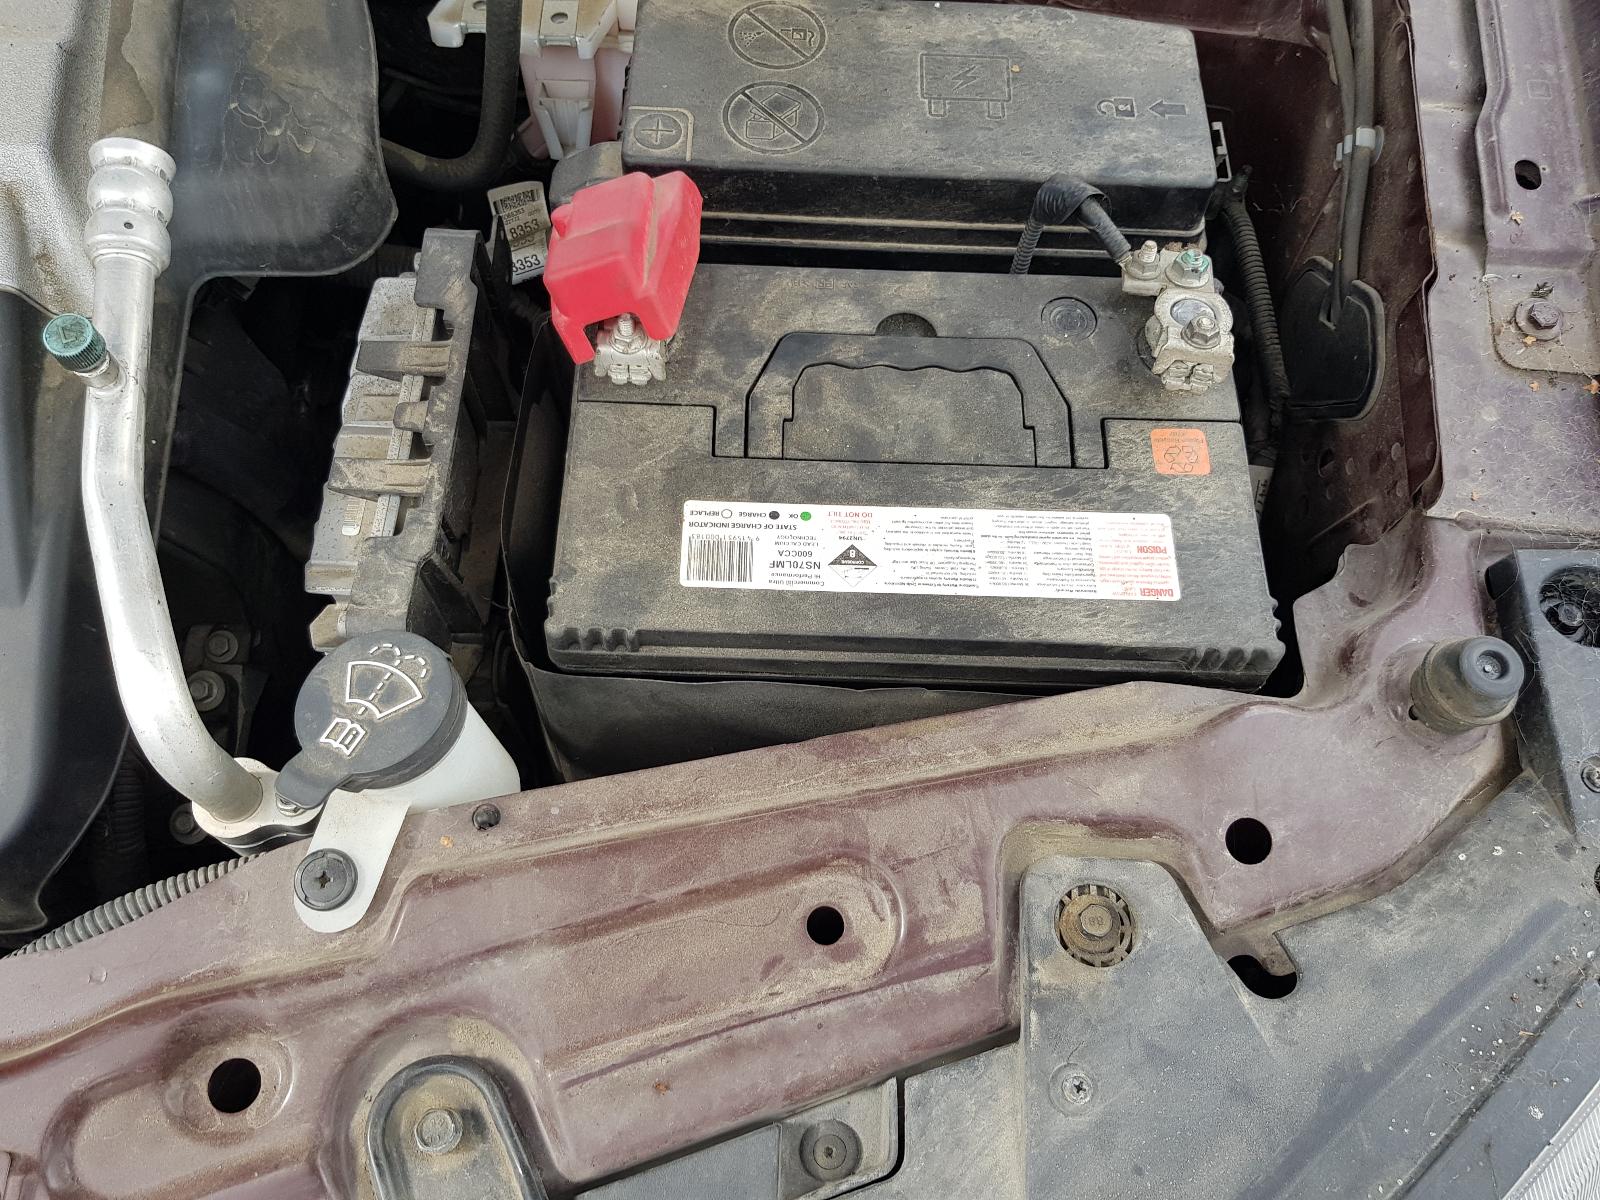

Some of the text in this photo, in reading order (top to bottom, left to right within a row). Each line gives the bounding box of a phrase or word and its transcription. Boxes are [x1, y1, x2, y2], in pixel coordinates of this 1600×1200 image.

[509, 218, 540, 239] 8353
[849, 550, 856, 558] 8
[1136, 546, 1167, 554] POISON
[769, 560, 821, 570] NS70LMF
[1140, 588, 1174, 597] DANGER
